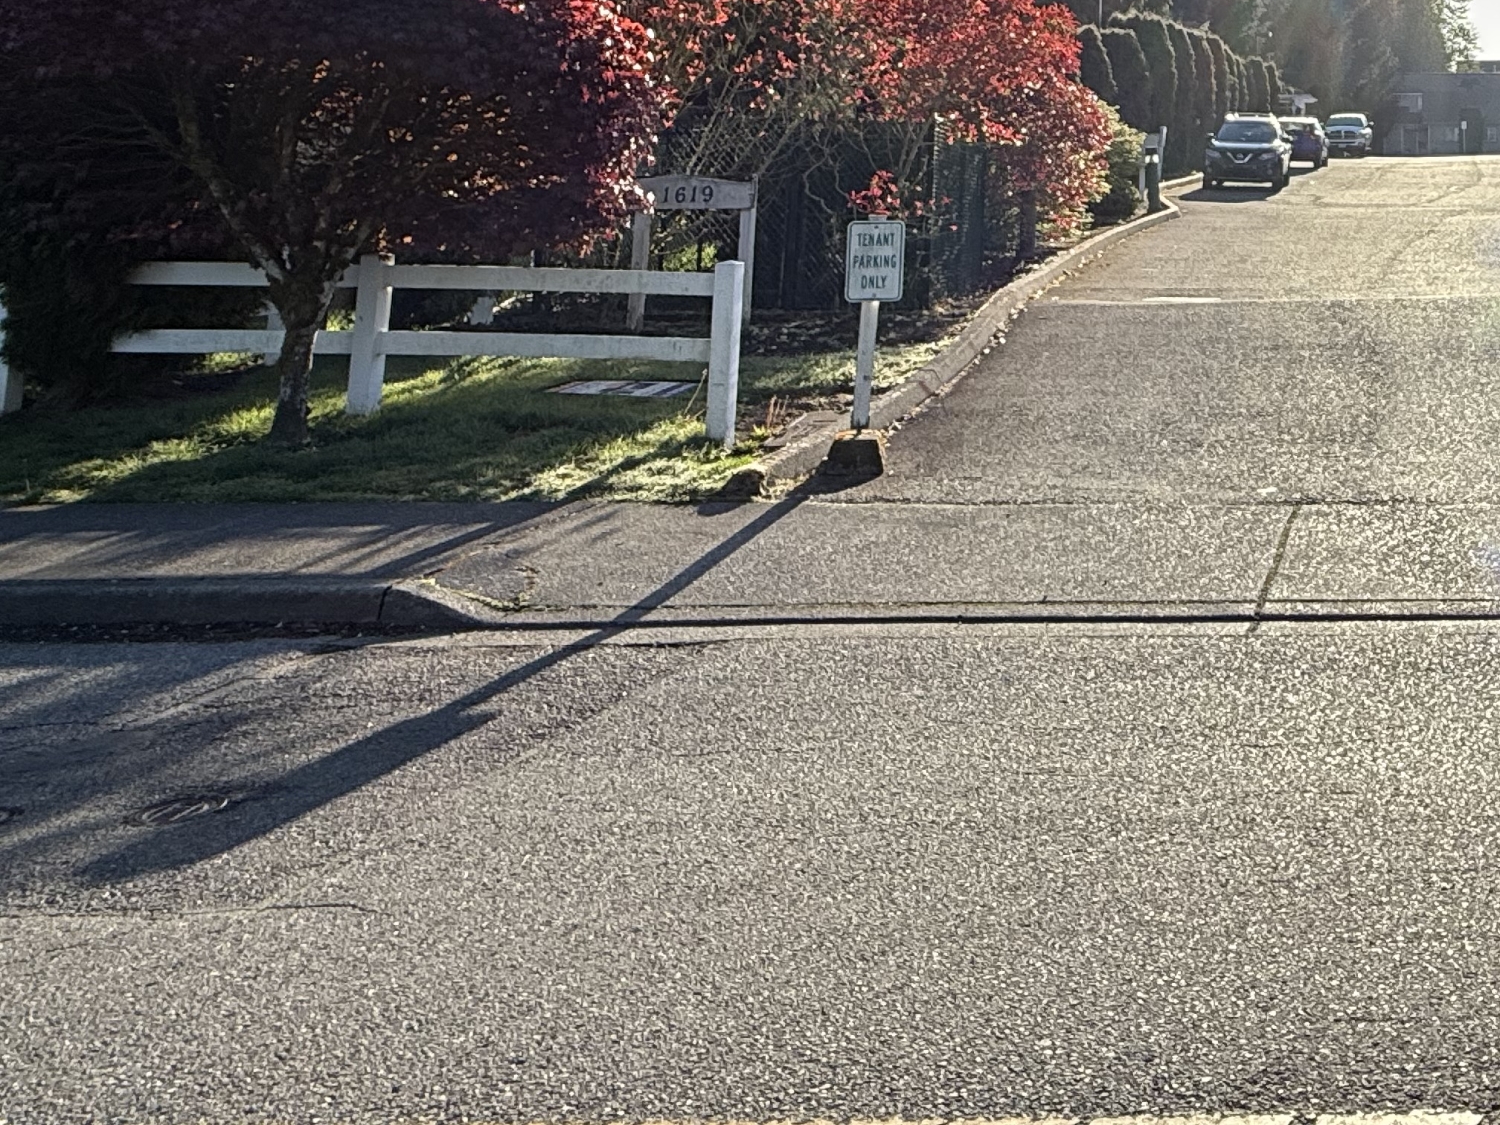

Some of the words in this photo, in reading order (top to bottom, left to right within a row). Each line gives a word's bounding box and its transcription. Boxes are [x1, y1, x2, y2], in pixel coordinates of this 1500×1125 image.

[663, 185, 714, 203] 1619
[857, 233, 895, 247] TENANT
[853, 254, 897, 269] PARKING
[861, 275, 887, 289] ONLY
